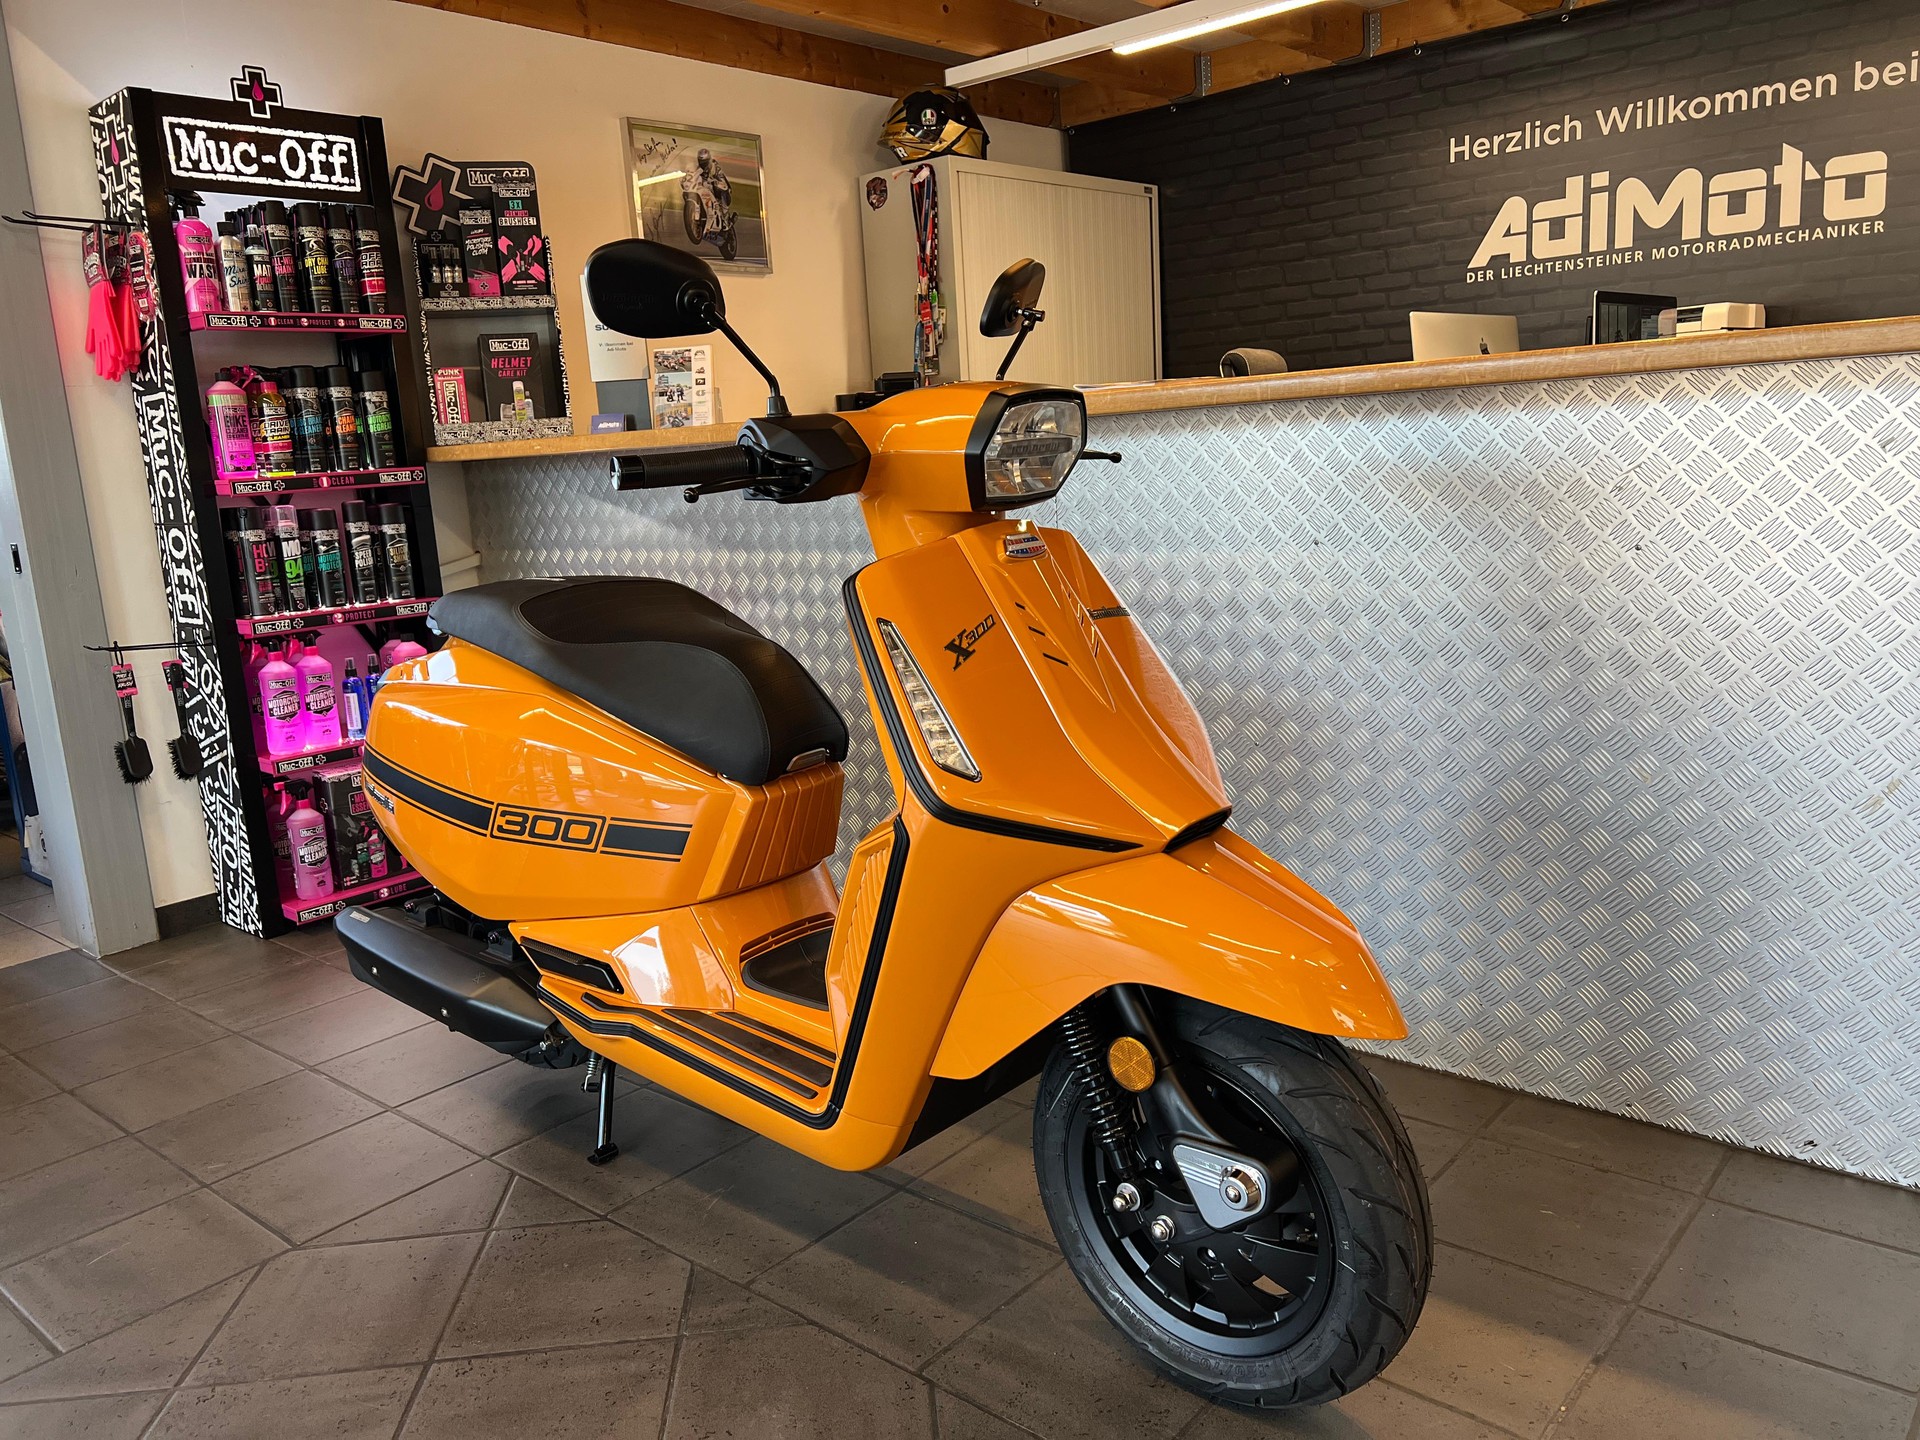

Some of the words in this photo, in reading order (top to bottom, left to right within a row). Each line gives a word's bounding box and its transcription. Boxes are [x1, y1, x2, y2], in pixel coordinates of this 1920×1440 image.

[1449, 115, 1583, 163] Herzlich
[1596, 73, 1838, 136] Willkommen
[1854, 51, 1920, 92] bei
[174, 127, 355, 184] Muc-Off
[500, 188, 530, 197] Muc-Off
[1467, 142, 1888, 269] AdiMoto
[499, 217, 522, 226] BRUSH
[523, 217, 537, 225] SET
[1466, 269, 1495, 284] DER
[1501, 250, 1643, 279] LIECHTENSTEINER
[1651, 220, 1885, 260] MOTORRADMECHANIKER
[424, 301, 451, 309] Muc-Off
[474, 299, 501, 307] Muc-Off
[525, 298, 551, 306] Muc-Off
[210, 316, 247, 327] Muc-Off
[360, 318, 391, 328] Muc-Off
[491, 340, 528, 350] Muc-Off
[491, 356, 532, 369] HELMET
[498, 370, 514, 378] CARE
[516, 369, 527, 377] KIT
[264, 419, 289, 429] DRIVE
[265, 427, 290, 436] TRAIN
[442, 431, 469, 439] Muc-Off
[493, 428, 519, 436] Muc-Off
[236, 482, 272, 494] Muc-Off
[331, 476, 355, 485] CLEAN
[380, 472, 411, 482] Muc-Off
[147, 403, 199, 616] Muc-Off
[256, 621, 291, 634] Muc-Off
[345, 610, 376, 621] PROTECT
[397, 605, 427, 615] Muc-Off
[269, 679, 296, 689] Muc-Off
[306, 673, 332, 684] Muc-Off
[272, 703, 299, 716] CLEANER
[310, 697, 335, 710] CLEANER
[280, 758, 313, 772] Muc-Off
[300, 824, 324, 837] Muc-Off
[496, 809, 599, 846] 300
[304, 848, 328, 863] CLEANER
[390, 883, 407, 895] LUBE
[301, 905, 333, 921] Muc-Off
